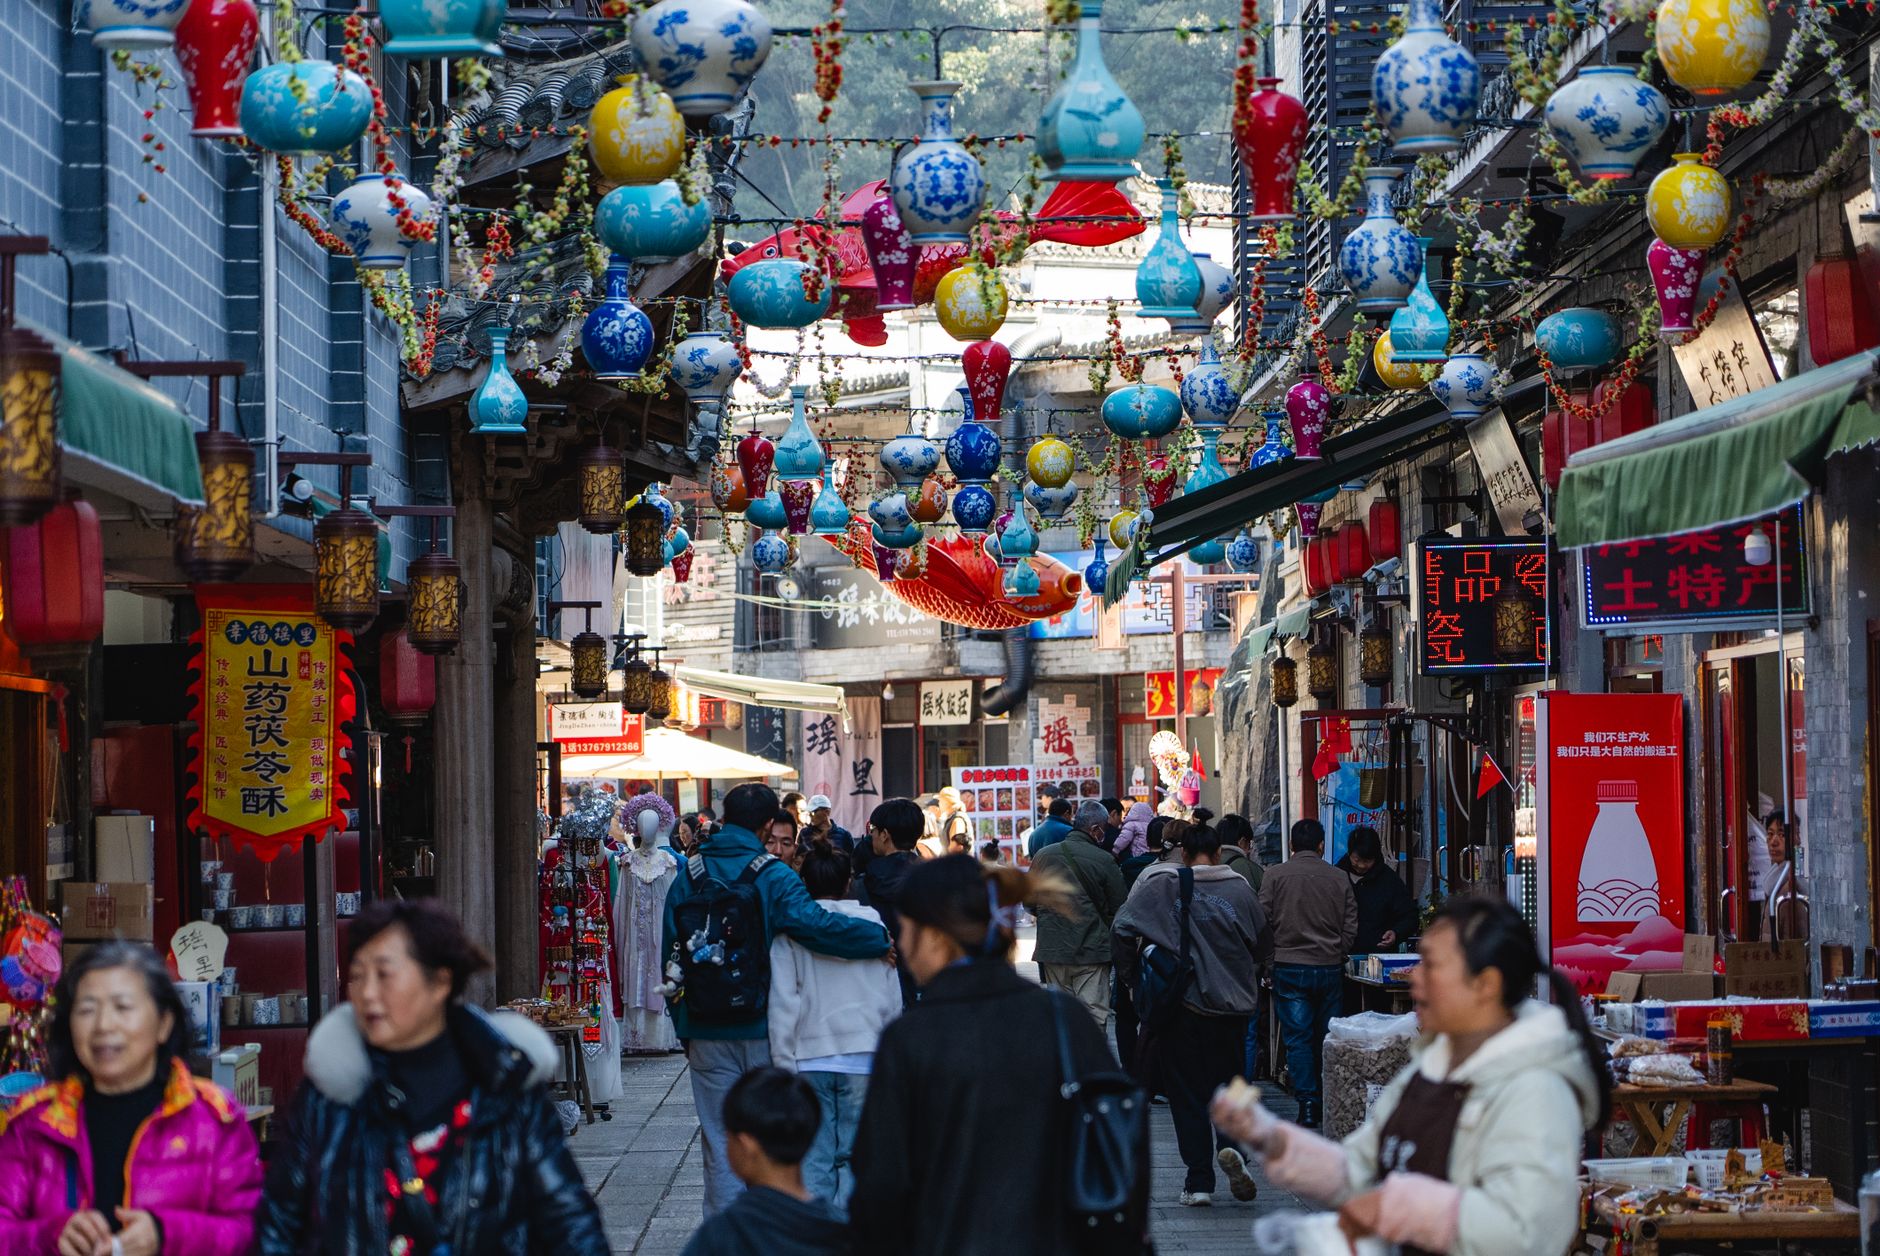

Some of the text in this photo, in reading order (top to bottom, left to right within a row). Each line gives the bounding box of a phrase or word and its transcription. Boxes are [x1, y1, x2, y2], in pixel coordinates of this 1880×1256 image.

[1601, 562, 1793, 612] 土特产
[226, 621, 316, 646] 幸福瑶里
[310, 660, 328, 724] 传统手工
[212, 657, 230, 801] 传承经典 匠心制作
[239, 648, 293, 819] 山药茯苓酥
[1556, 745, 1678, 758] 我们只是大自然的搬运工
[1583, 731, 1650, 743] 我们不生产水
[178, 929, 215, 976] 瑶里
